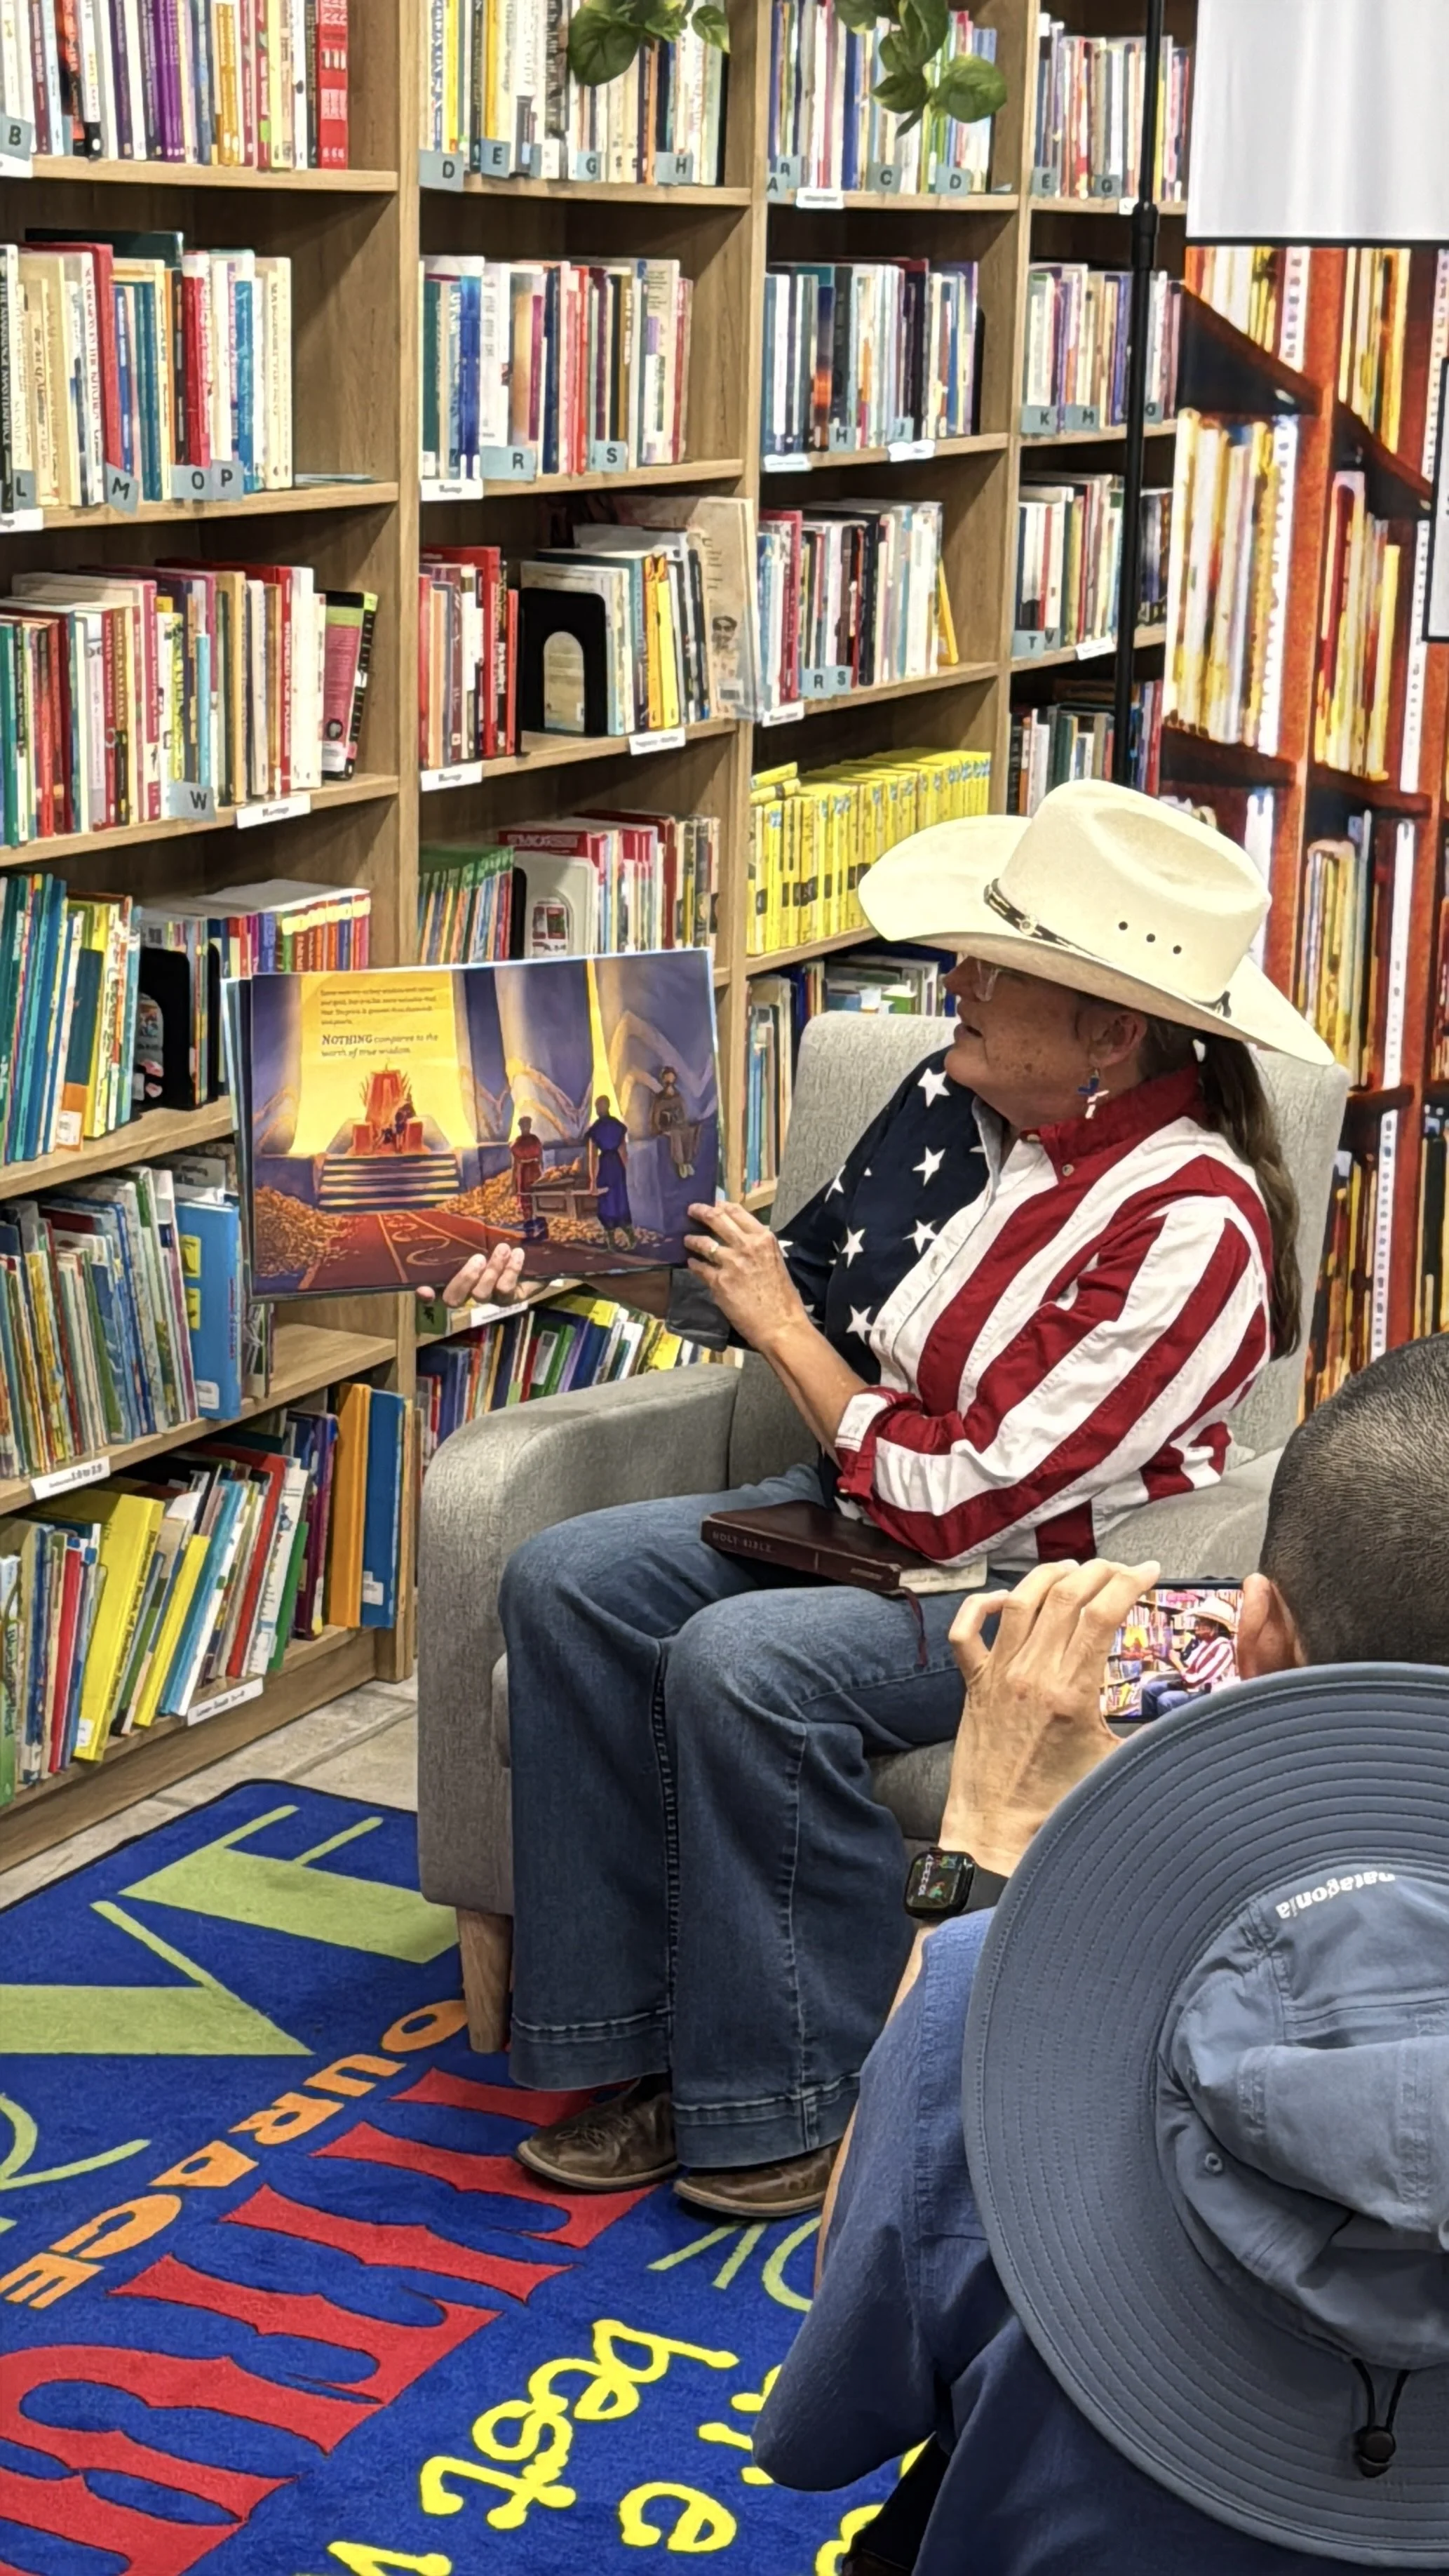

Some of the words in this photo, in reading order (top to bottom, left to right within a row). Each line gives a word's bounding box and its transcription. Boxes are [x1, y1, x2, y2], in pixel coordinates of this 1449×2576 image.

[9, 125, 21, 146] B
[492, 147, 503, 166] E
[442, 161, 455, 180] D
[586, 157, 597, 174] G
[675, 157, 687, 174] H
[767, 177, 779, 193] A
[880, 170, 892, 185] C
[950, 173, 961, 189] D
[1042, 173, 1051, 189] E
[1039, 411, 1050, 425] K
[1082, 410, 1095, 424] M
[835, 428, 847, 444] H
[512, 452, 524, 470] R
[607, 448, 618, 464] S
[16, 477, 26, 497] L
[191, 473, 204, 490] O
[221, 469, 233, 488] P
[112, 477, 130, 500] M
[1027, 636, 1037, 650] T
[814, 674, 823, 688] R
[837, 671, 847, 685] S
[190, 791, 207, 810] W
[322, 1034, 372, 1045] NOTHING
[712, 1530, 738, 1547] HOLY
[419, 2319, 737, 2530] best
